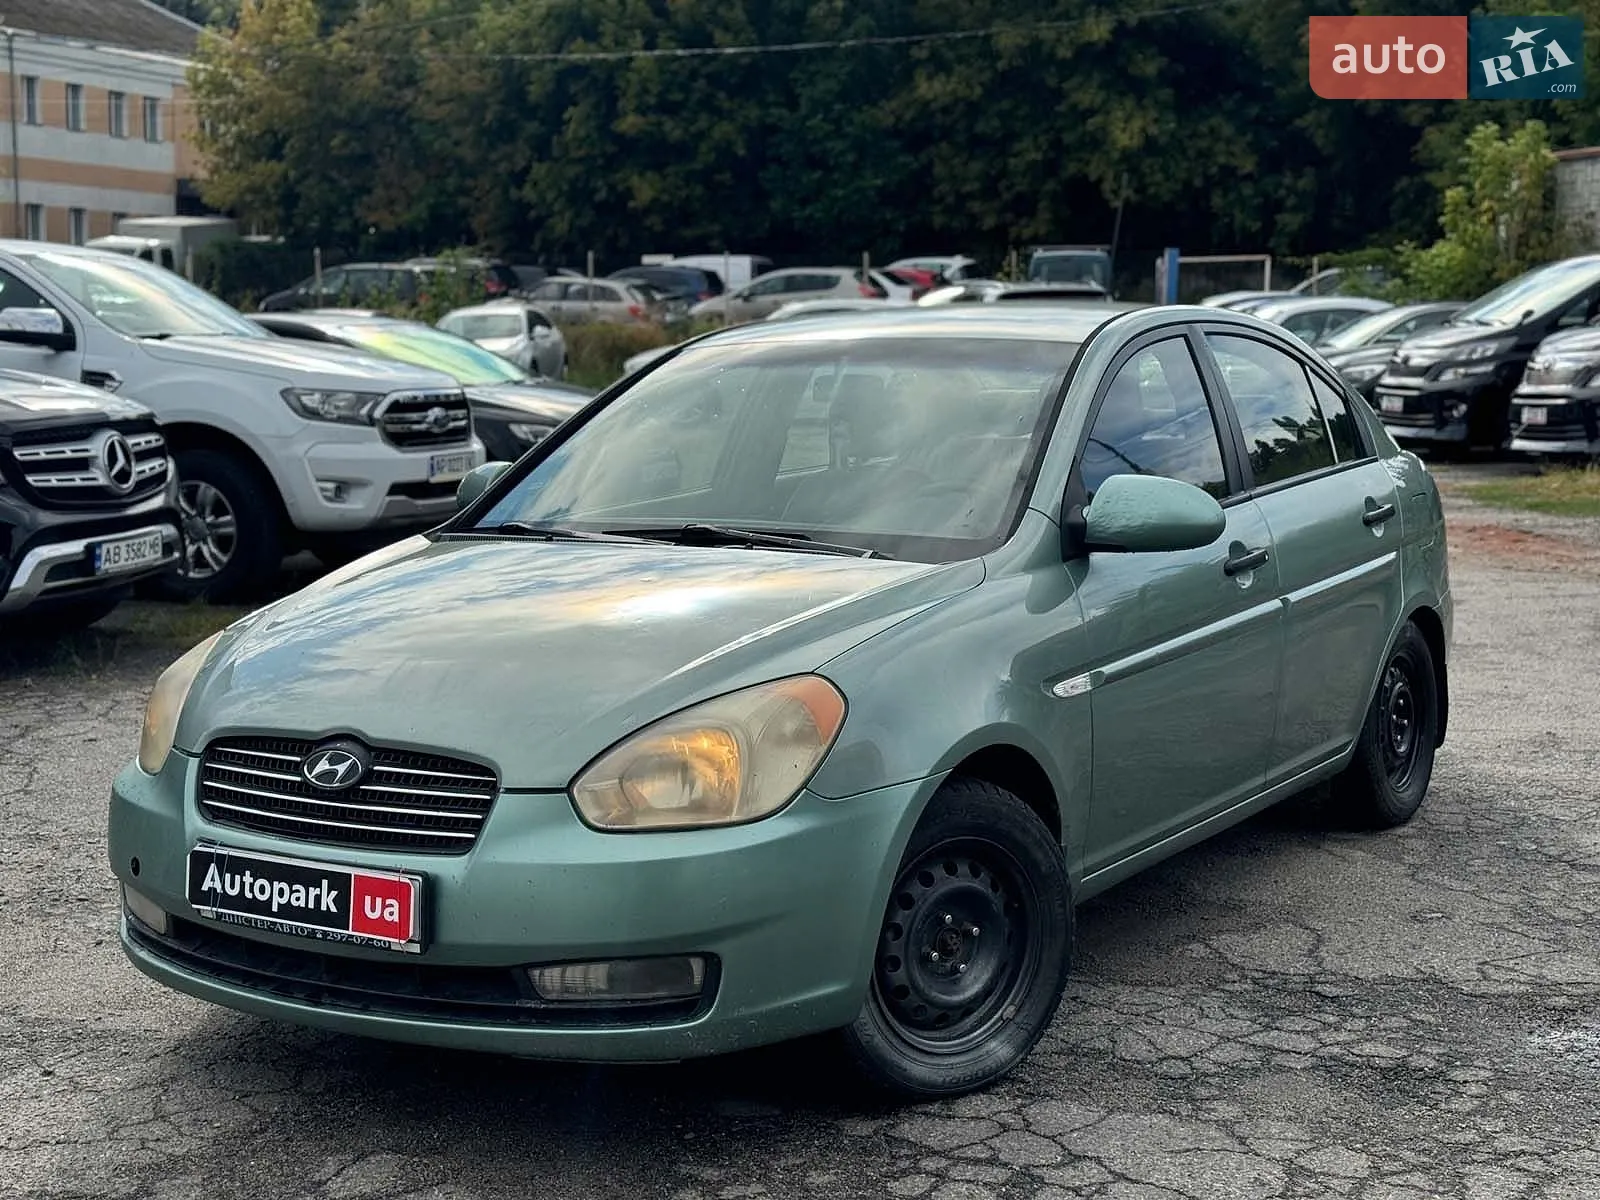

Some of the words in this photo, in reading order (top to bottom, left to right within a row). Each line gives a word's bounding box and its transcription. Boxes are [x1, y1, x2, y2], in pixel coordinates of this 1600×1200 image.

[104, 544, 121, 565] AB
[201, 863, 338, 913] Autopark
[364, 895, 399, 923] ua
[326, 930, 389, 948] 297-07-60
